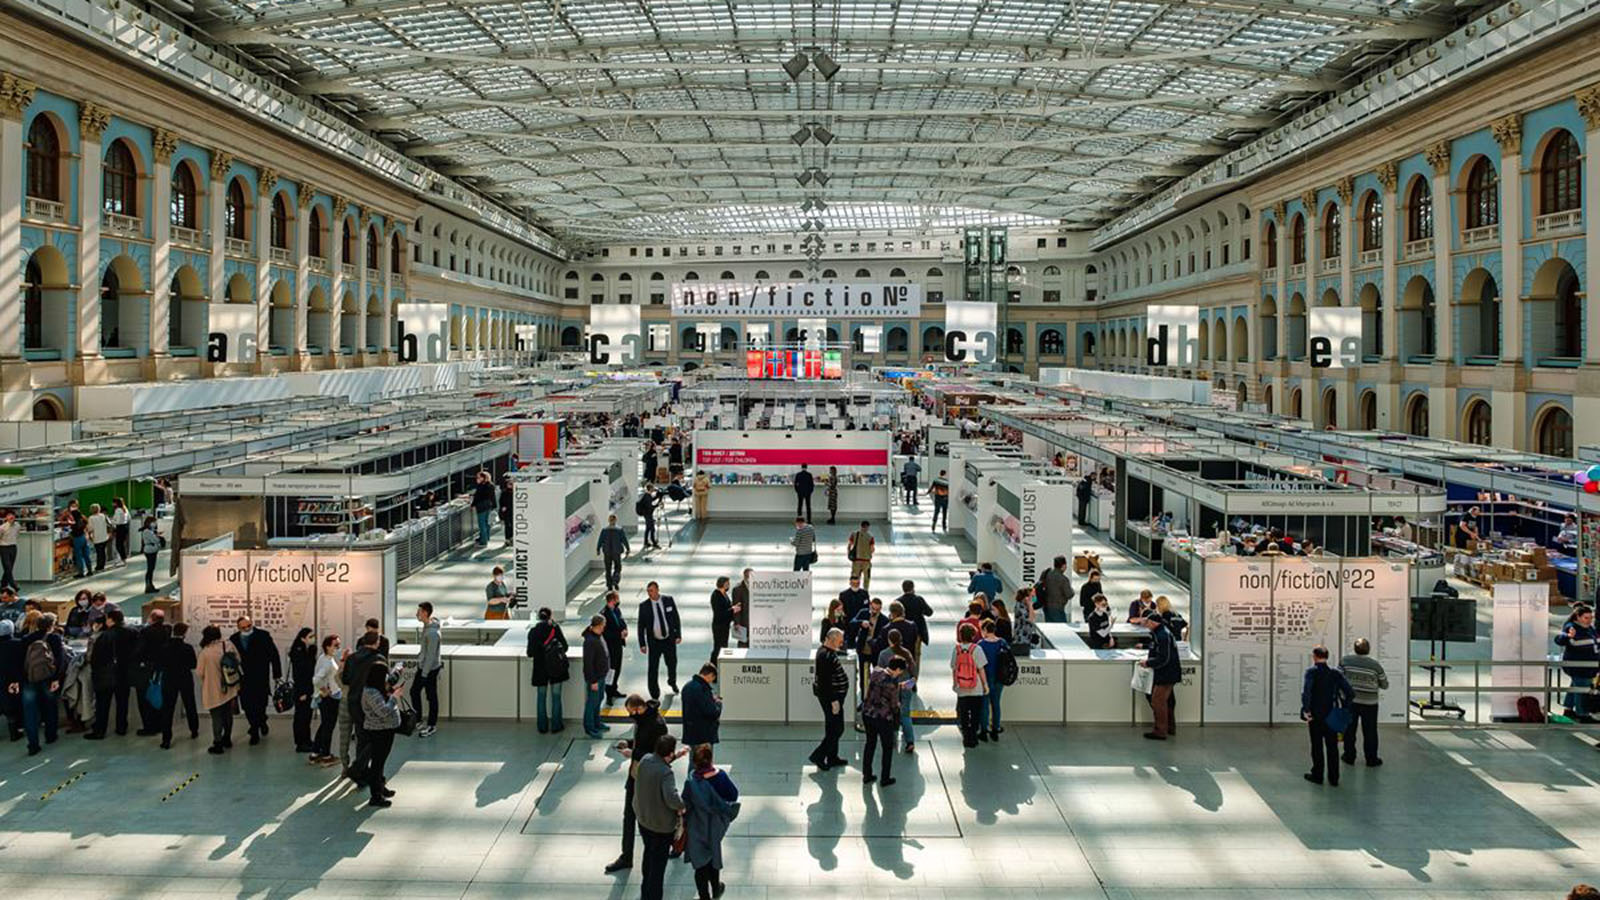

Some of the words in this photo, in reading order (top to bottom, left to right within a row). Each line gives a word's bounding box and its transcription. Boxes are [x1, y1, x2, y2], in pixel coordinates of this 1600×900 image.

[515, 487, 528, 536] TOP-LIST
[1023, 488, 1036, 537] TOP-LIST
[515, 548, 528, 609] ТОП-ЛИСТ
[742, 665, 762, 674] ВХОД
[1021, 666, 1041, 675] ВХОД
[733, 676, 771, 685] ENTRANCE
[1016, 677, 1049, 686] NTRANCE
